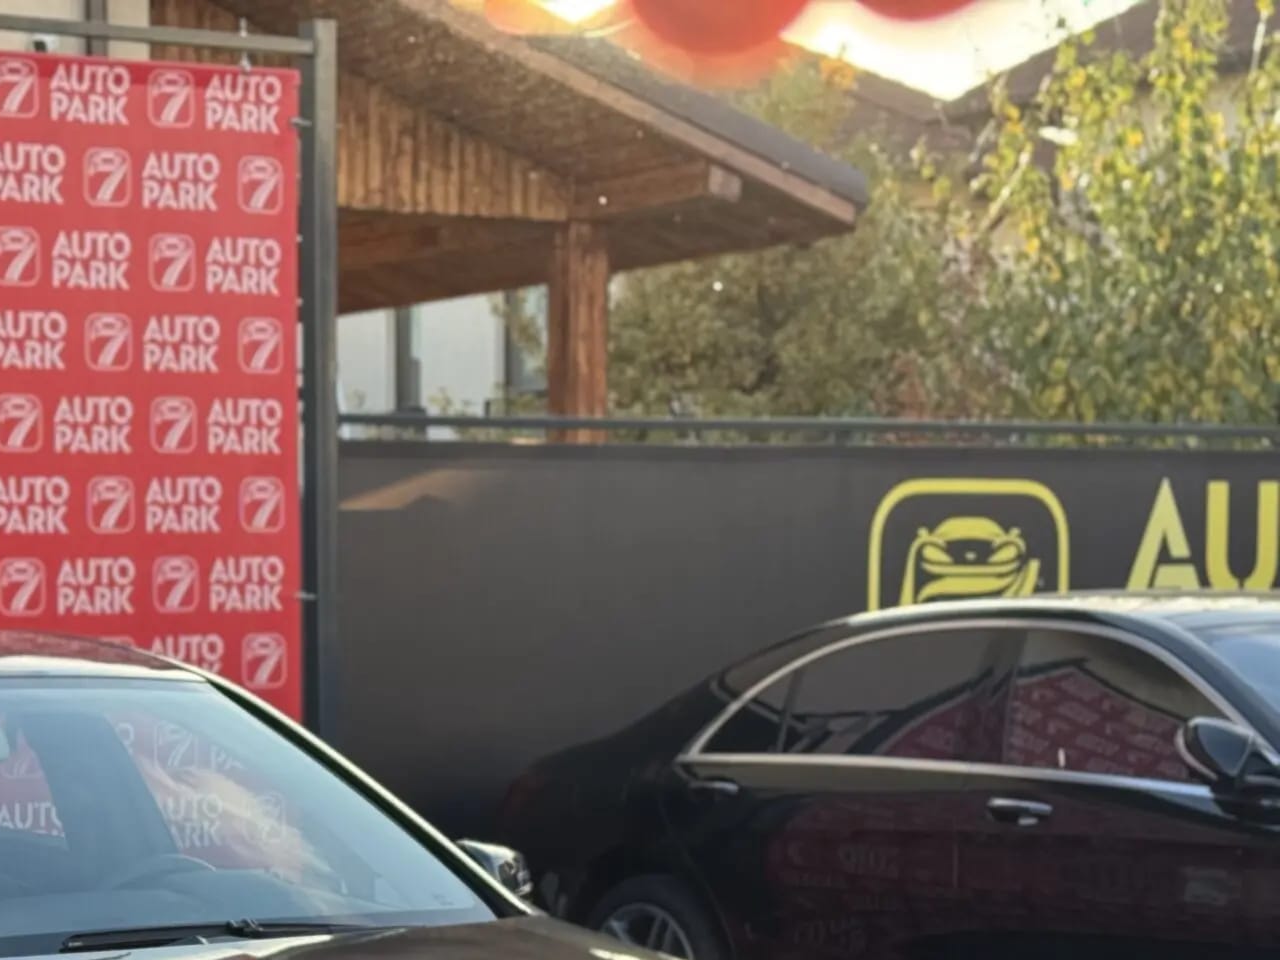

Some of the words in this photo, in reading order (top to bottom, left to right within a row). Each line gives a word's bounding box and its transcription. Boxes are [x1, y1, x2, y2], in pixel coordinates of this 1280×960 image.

[49, 64, 131, 97] AUTO
[203, 74, 282, 105] AUTO
[50, 90, 129, 125] PARK
[205, 99, 280, 135] PARK
[142, 152, 220, 182] AUTO
[142, 179, 218, 211] PARK
[52, 230, 132, 261] AUTO
[205, 237, 282, 268] AUTO
[52, 257, 130, 290] PARK
[206, 264, 279, 296] PARK
[143, 315, 221, 345] AUTO
[143, 341, 219, 373] PARK
[53, 396, 134, 425] AUTO
[207, 398, 283, 428] AUTO
[54, 423, 132, 454] PARK
[207, 423, 281, 455] PARK
[145, 476, 222, 505] AUTO
[145, 503, 221, 533] PARK
[57, 556, 136, 587] AUTO
[209, 555, 285, 584] AUTO
[57, 585, 134, 615] PARK
[209, 582, 283, 612] PARK
